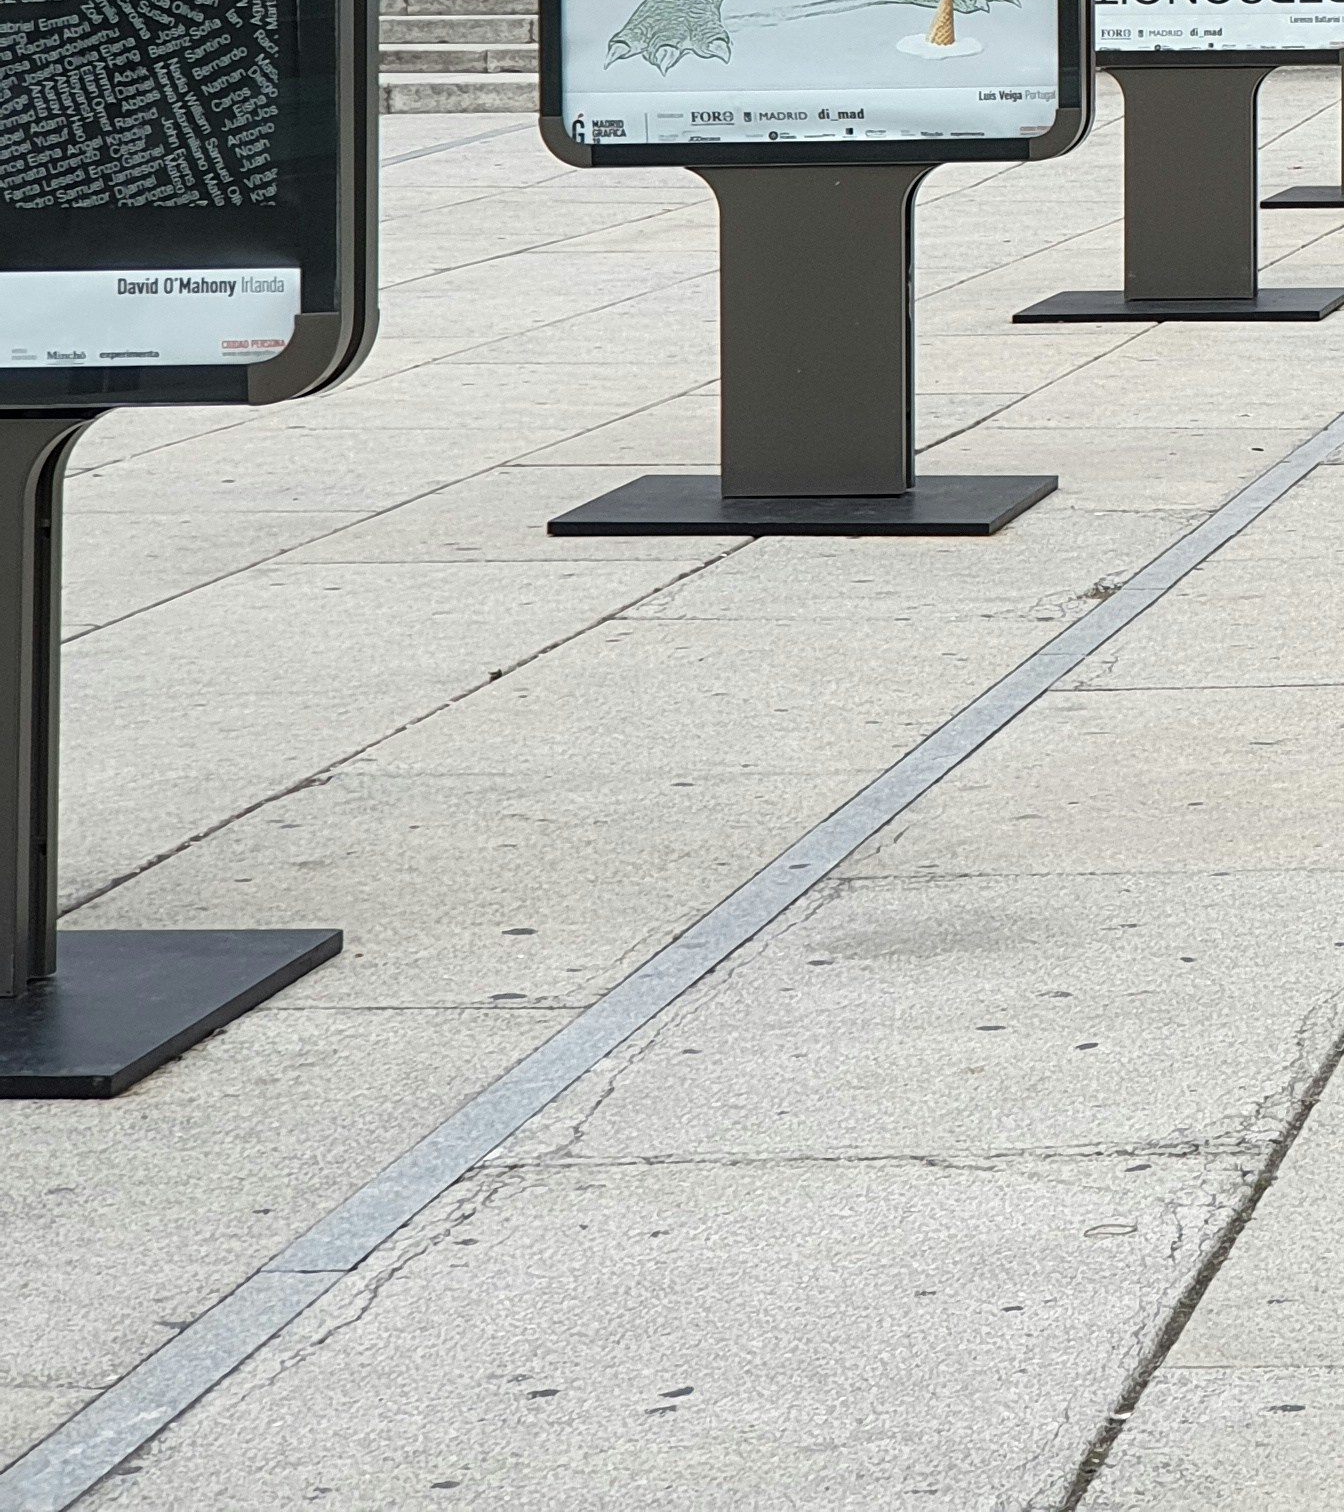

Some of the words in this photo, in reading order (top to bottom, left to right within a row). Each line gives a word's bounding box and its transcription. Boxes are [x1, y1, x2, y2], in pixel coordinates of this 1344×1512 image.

[1149, 29, 1183, 37] MADRID
[999, 90, 1022, 102] Veiga
[759, 112, 808, 121] MADRID
[818, 108, 865, 122] di_mad
[592, 120, 624, 129] MADRID
[117, 277, 158, 295] David
[241, 276, 285, 293] Irlanda
